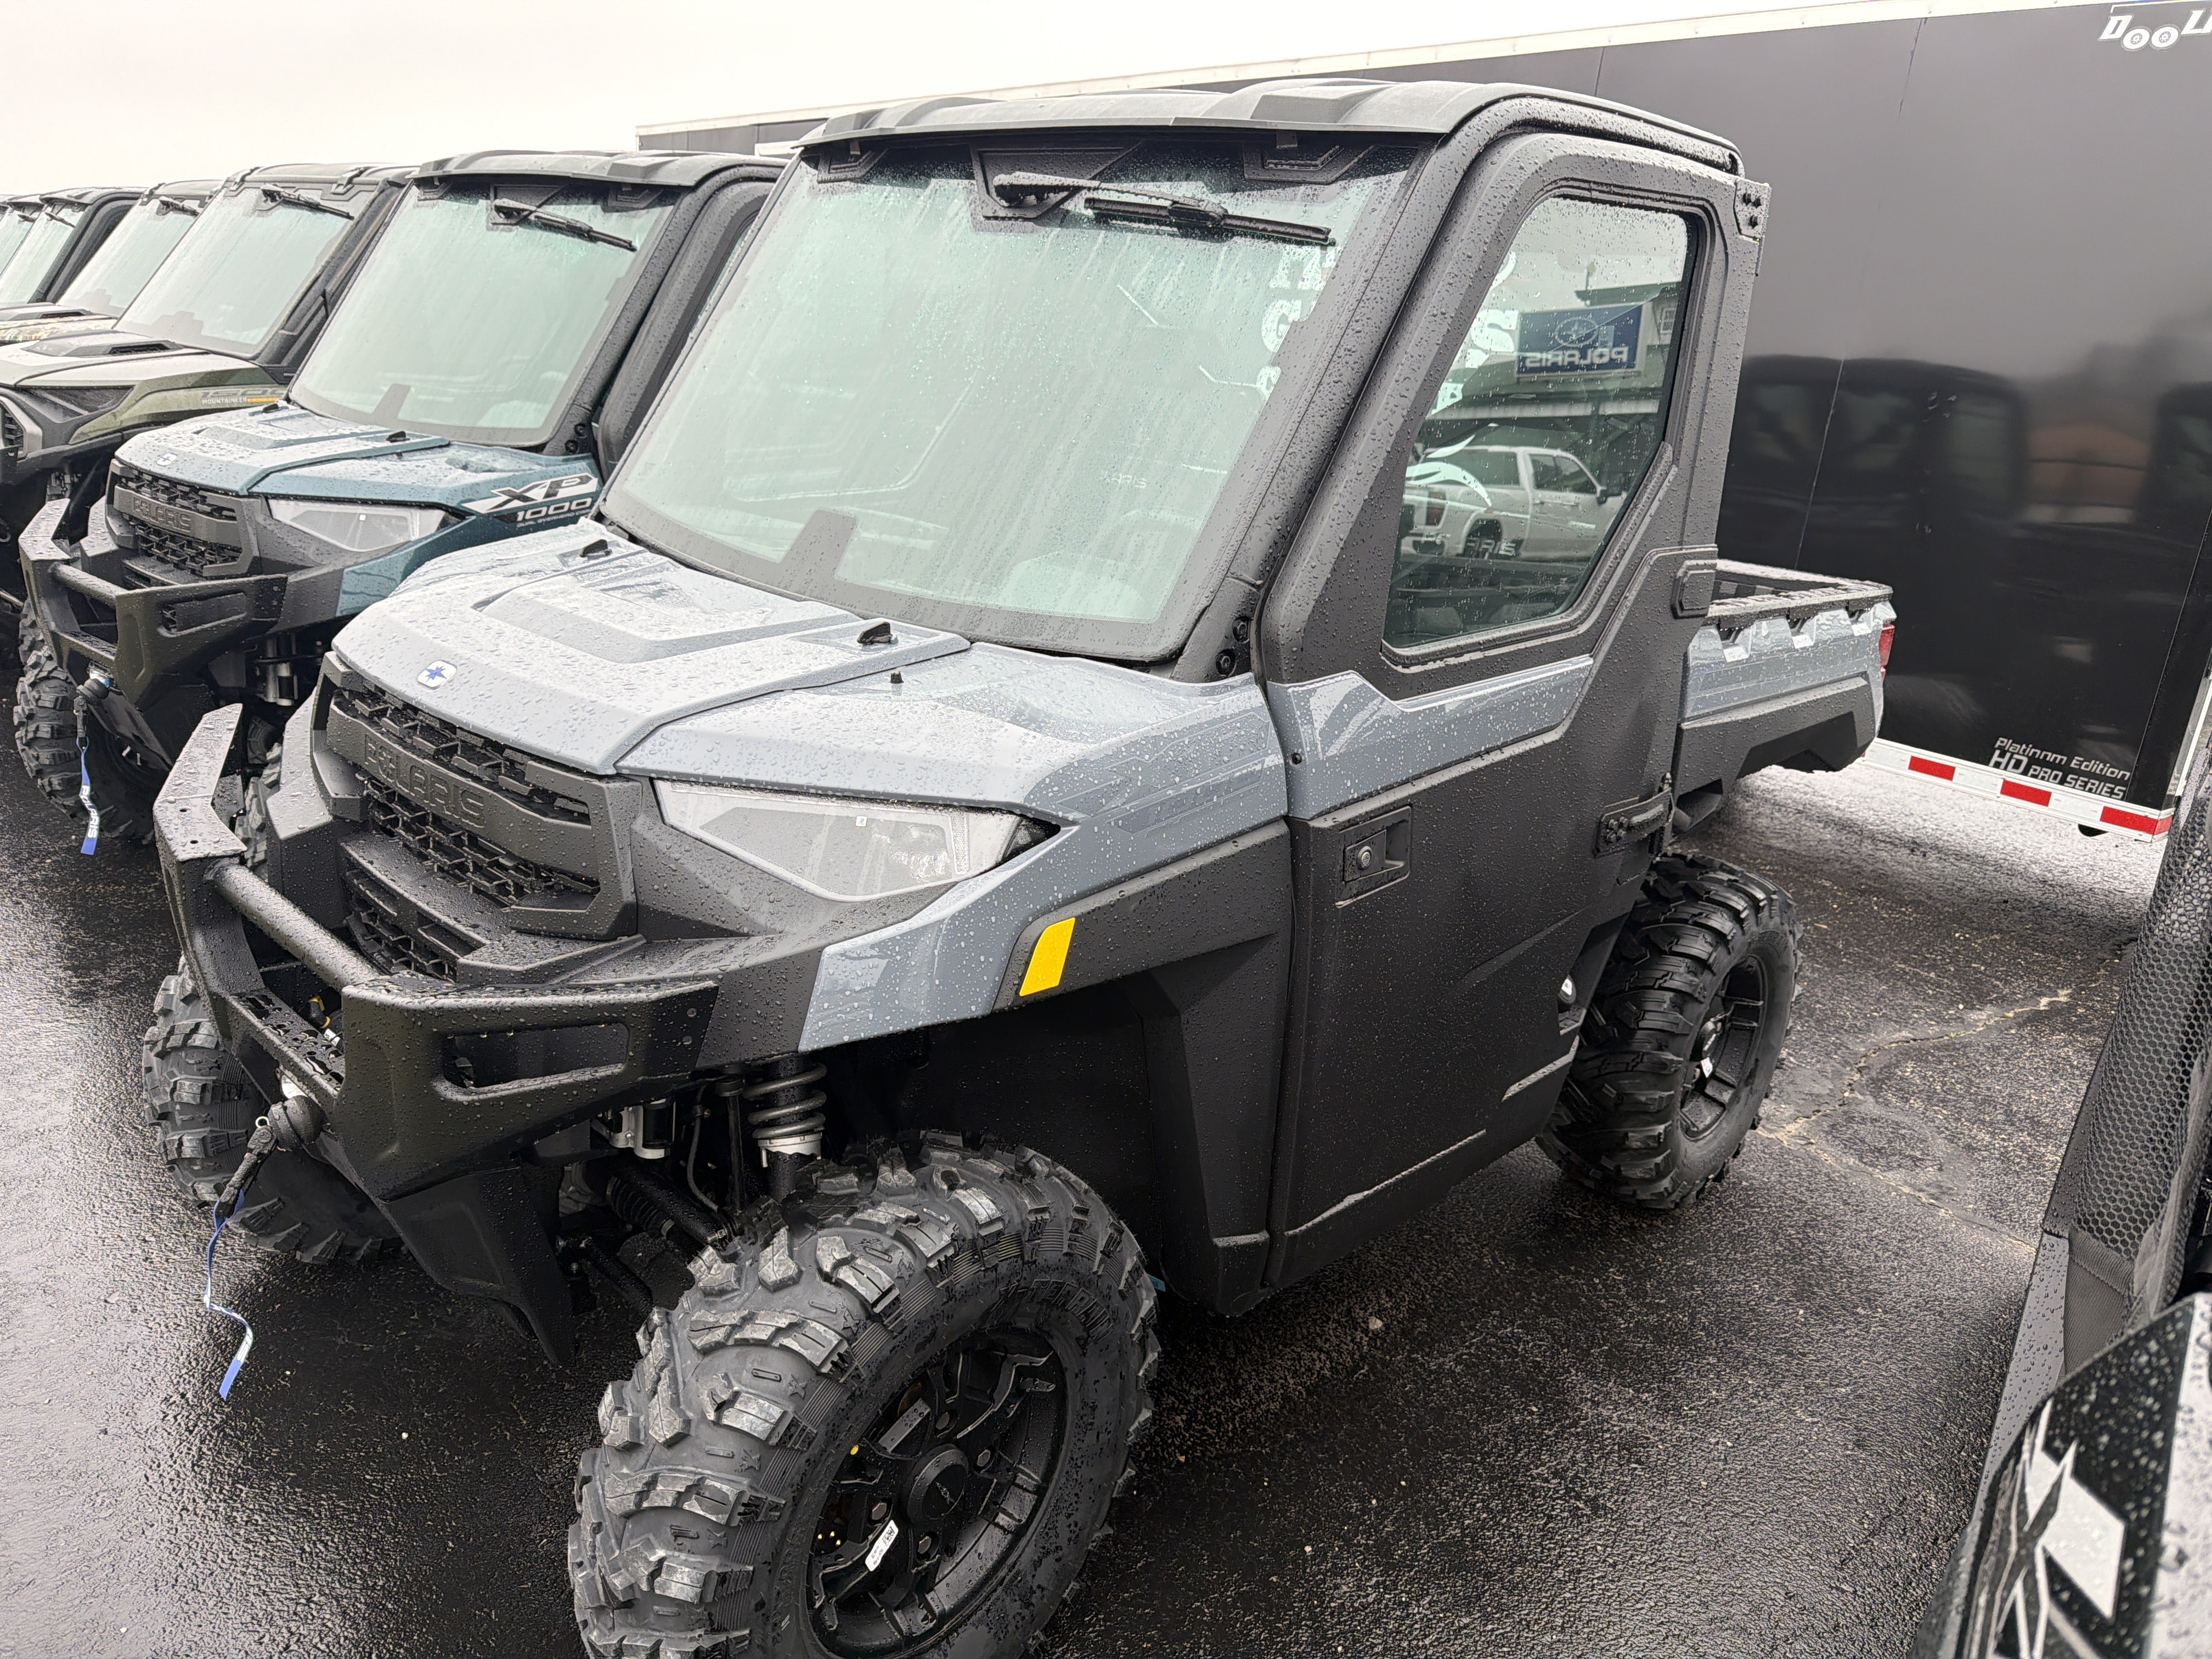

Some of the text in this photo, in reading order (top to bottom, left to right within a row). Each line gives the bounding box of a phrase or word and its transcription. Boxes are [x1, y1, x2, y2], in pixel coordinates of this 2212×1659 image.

[483, 473, 596, 512] XP
[516, 498, 592, 521] 1000
[133, 496, 191, 533] POLARIS
[364, 733, 486, 828] POLARIS
[1989, 750, 2126, 799] HD PRO SERIES
[2069, 757, 2131, 781] Edition
[80, 785, 99, 838] POLARIS
